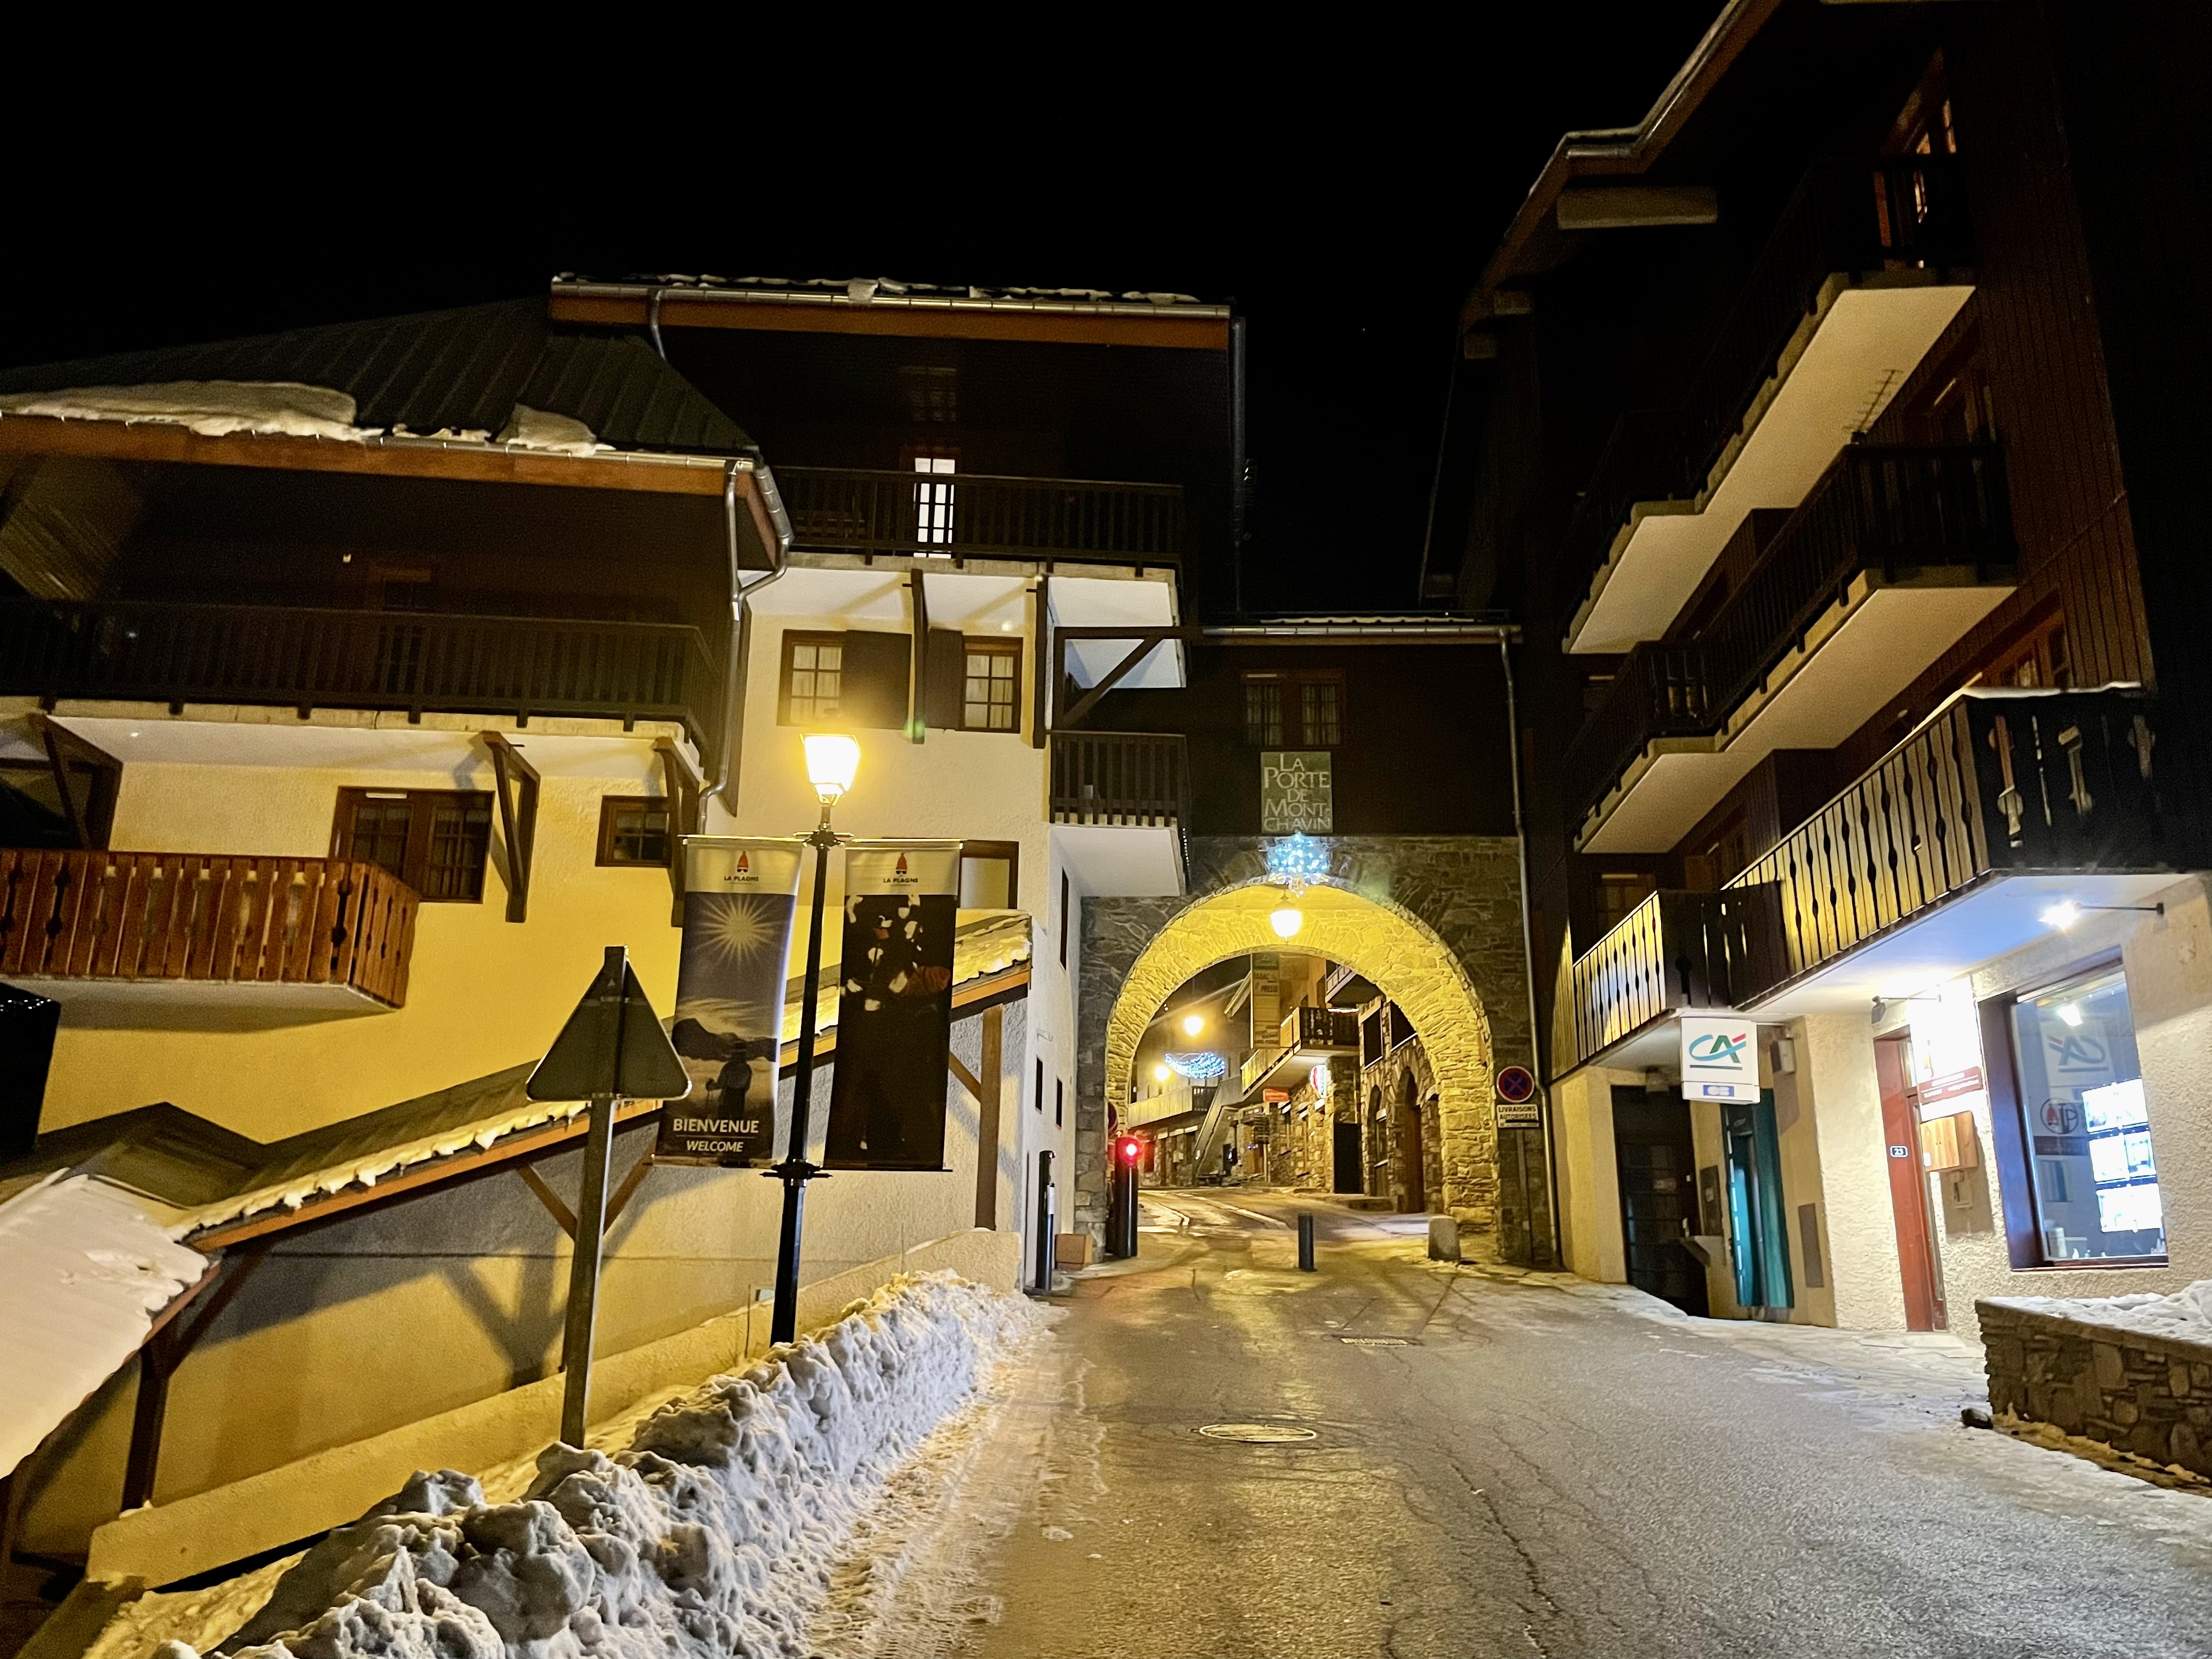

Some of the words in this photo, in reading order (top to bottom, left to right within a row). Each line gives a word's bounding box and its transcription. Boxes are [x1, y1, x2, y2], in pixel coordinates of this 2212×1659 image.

[1280, 753, 1305, 771] LA
[1264, 766, 1330, 788] PORTE
[1287, 788, 1309, 803] DE
[1264, 817, 1330, 832] CHAVIN
[1689, 1033, 1746, 1064] CA
[673, 1119, 759, 1133] BIENVENUE
[686, 1140, 744, 1152] WELCOME
